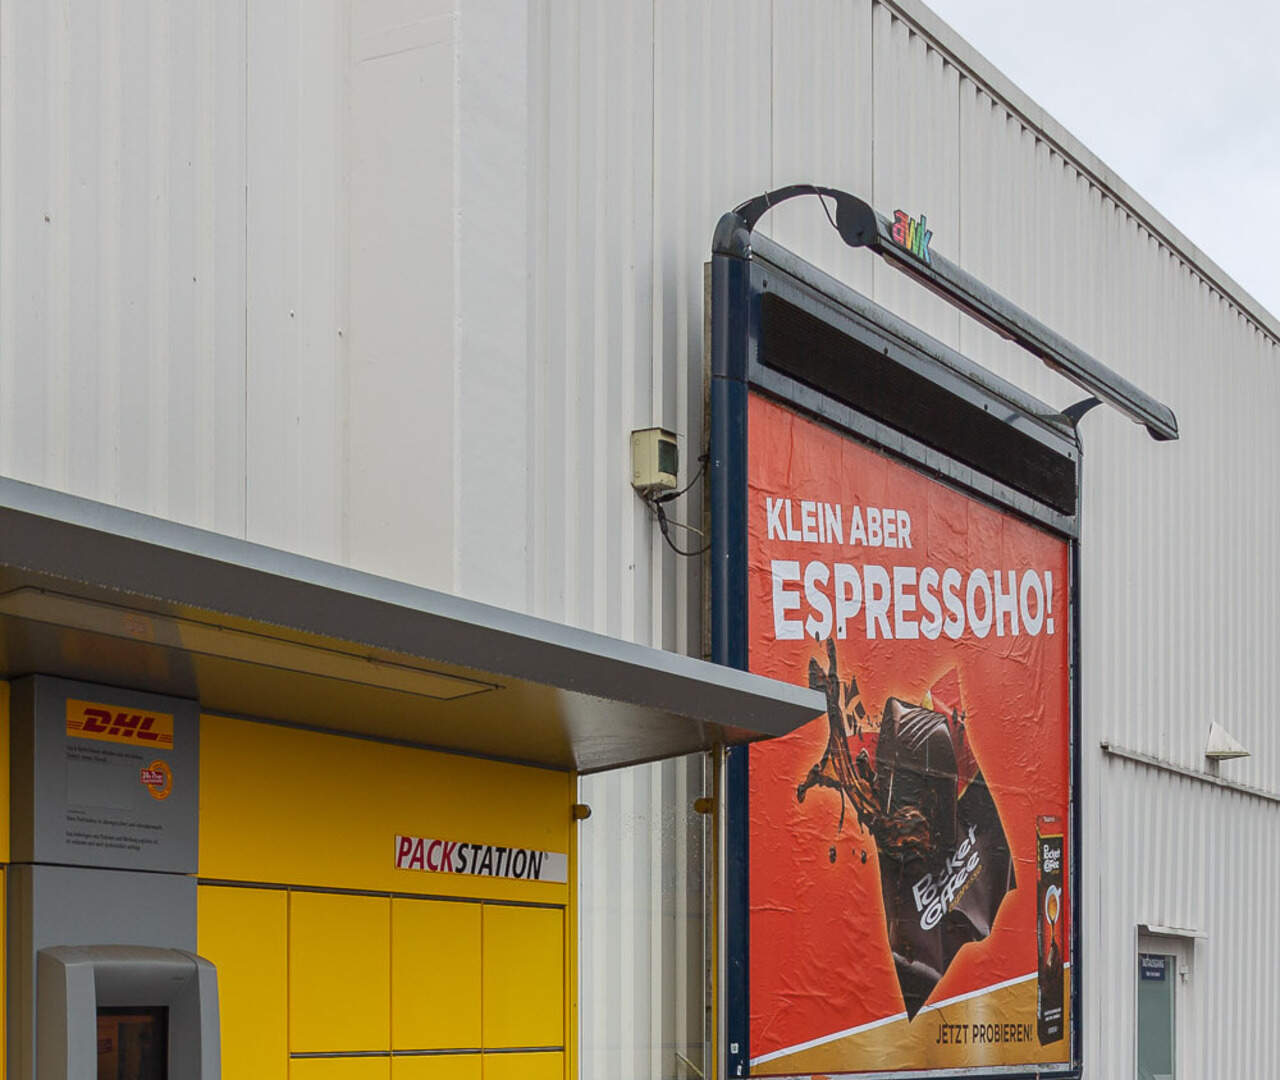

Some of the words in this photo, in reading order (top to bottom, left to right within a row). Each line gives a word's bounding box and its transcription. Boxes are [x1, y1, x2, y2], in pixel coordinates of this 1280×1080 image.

[766, 497, 843, 545] KLEIN
[849, 505, 912, 549] ABER
[771, 559, 1055, 641] ESPRESSOHO!
[82, 708, 159, 741] DHL
[396, 836, 543, 880] PACKSTATION
[920, 851, 980, 931] Coffee
[936, 1023, 969, 1044] JETZT
[972, 1023, 1033, 1043] PROBIEREN!
